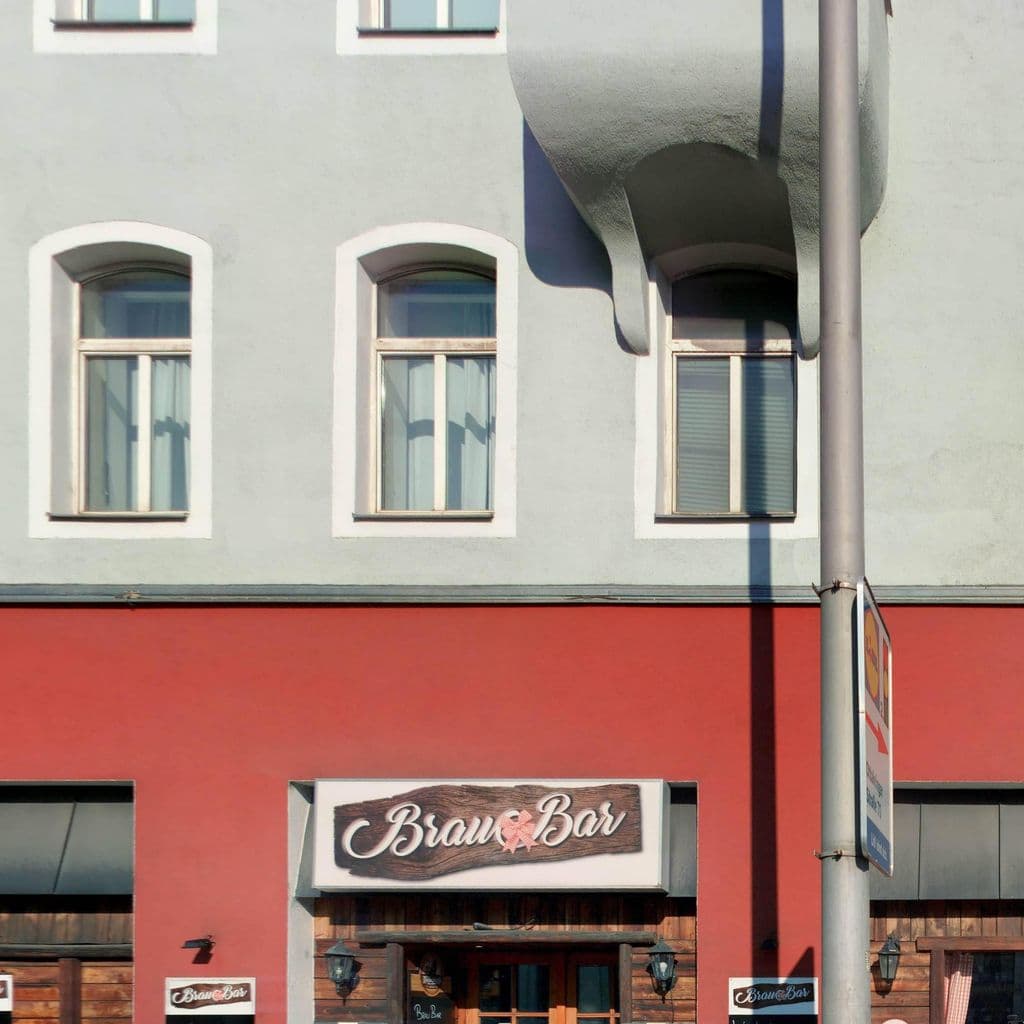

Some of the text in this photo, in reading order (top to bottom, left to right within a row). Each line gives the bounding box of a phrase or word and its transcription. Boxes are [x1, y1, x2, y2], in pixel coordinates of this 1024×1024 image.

[341, 792, 627, 860] Brau Bar
[172, 984, 248, 1004] Brau Bar
[735, 984, 811, 1004] Brau Bar
